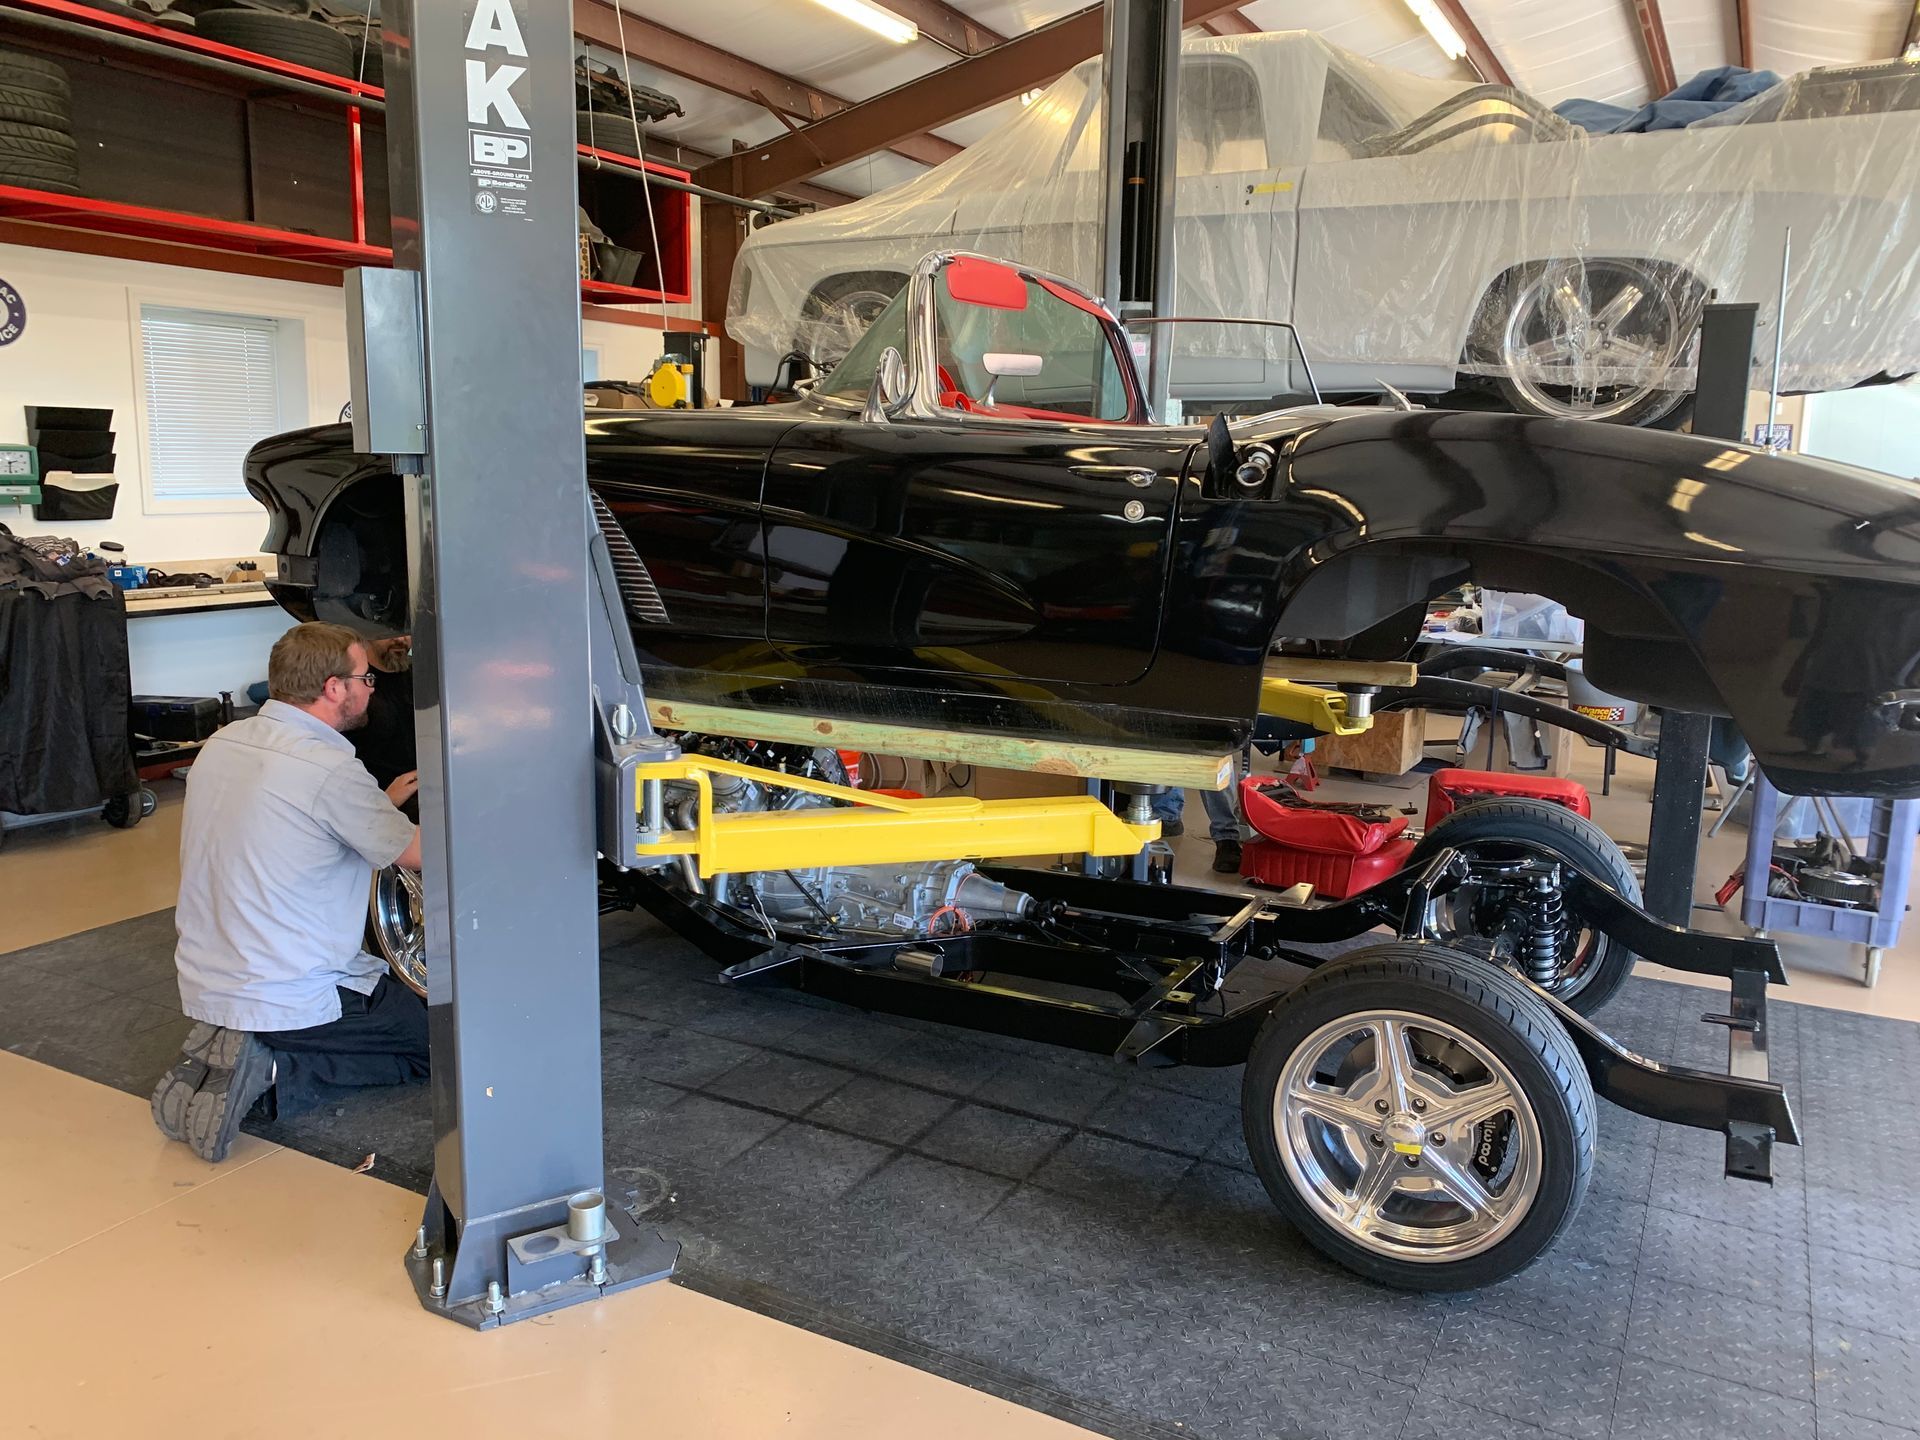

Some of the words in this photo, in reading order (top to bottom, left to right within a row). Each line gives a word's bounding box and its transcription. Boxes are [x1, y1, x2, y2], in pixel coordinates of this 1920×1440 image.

[473, 134, 528, 165] BP
[473, 169, 515, 178] ABOVE-GROUND
[1577, 706, 1610, 715] Advance
[1478, 1116, 1496, 1167] ilwood
